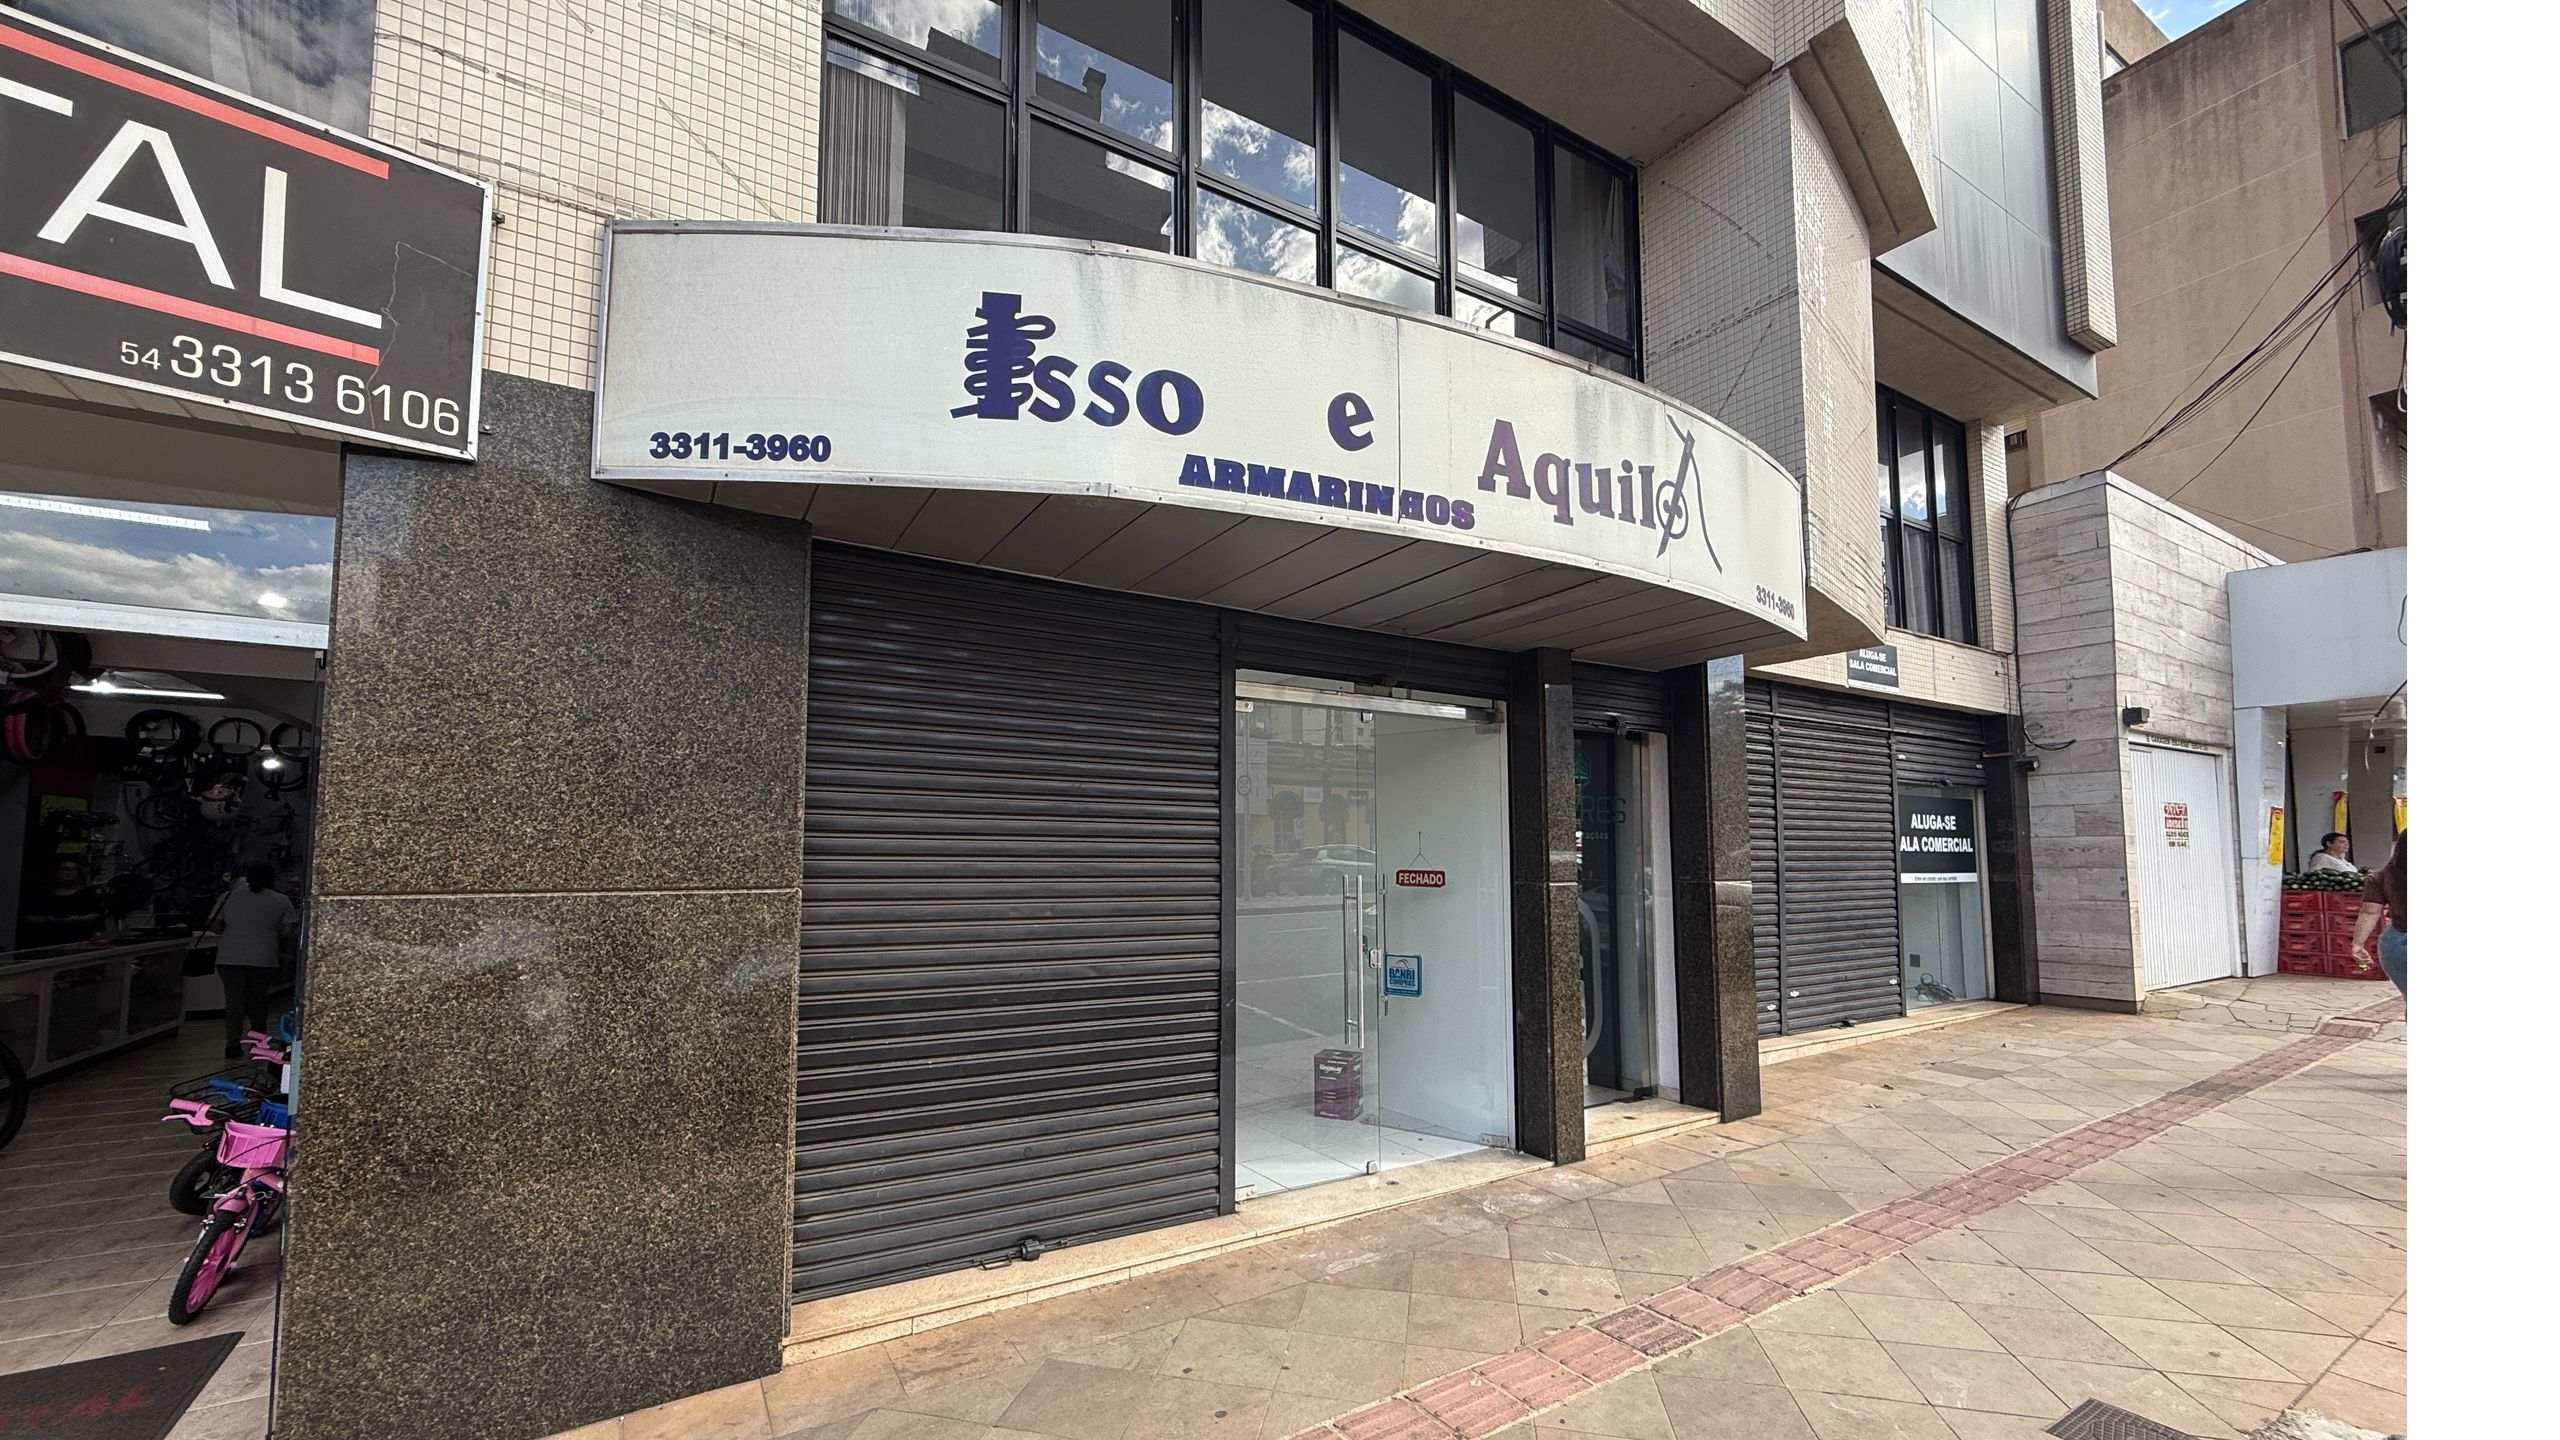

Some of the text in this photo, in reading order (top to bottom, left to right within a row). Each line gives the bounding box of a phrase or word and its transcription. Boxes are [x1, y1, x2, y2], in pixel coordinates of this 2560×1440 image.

[0, 78, 382, 329] AL
[952, 291, 1205, 436] Isso
[1327, 391, 1375, 452] e
[120, 335, 460, 437] 54 3313 6106
[649, 431, 832, 463] 3311-3960
[1178, 453, 1476, 531] ARMARINHOS
[1859, 648, 1887, 662] ALUGA-SE
[1848, 658, 1897, 677] SALA COMERCIAL
[1910, 813, 1957, 831] ALUGA-SE
[1921, 836, 1974, 853] COMERCIAL
[1398, 873, 1443, 886] FECHADO
[1388, 966, 1416, 980] BANRI
